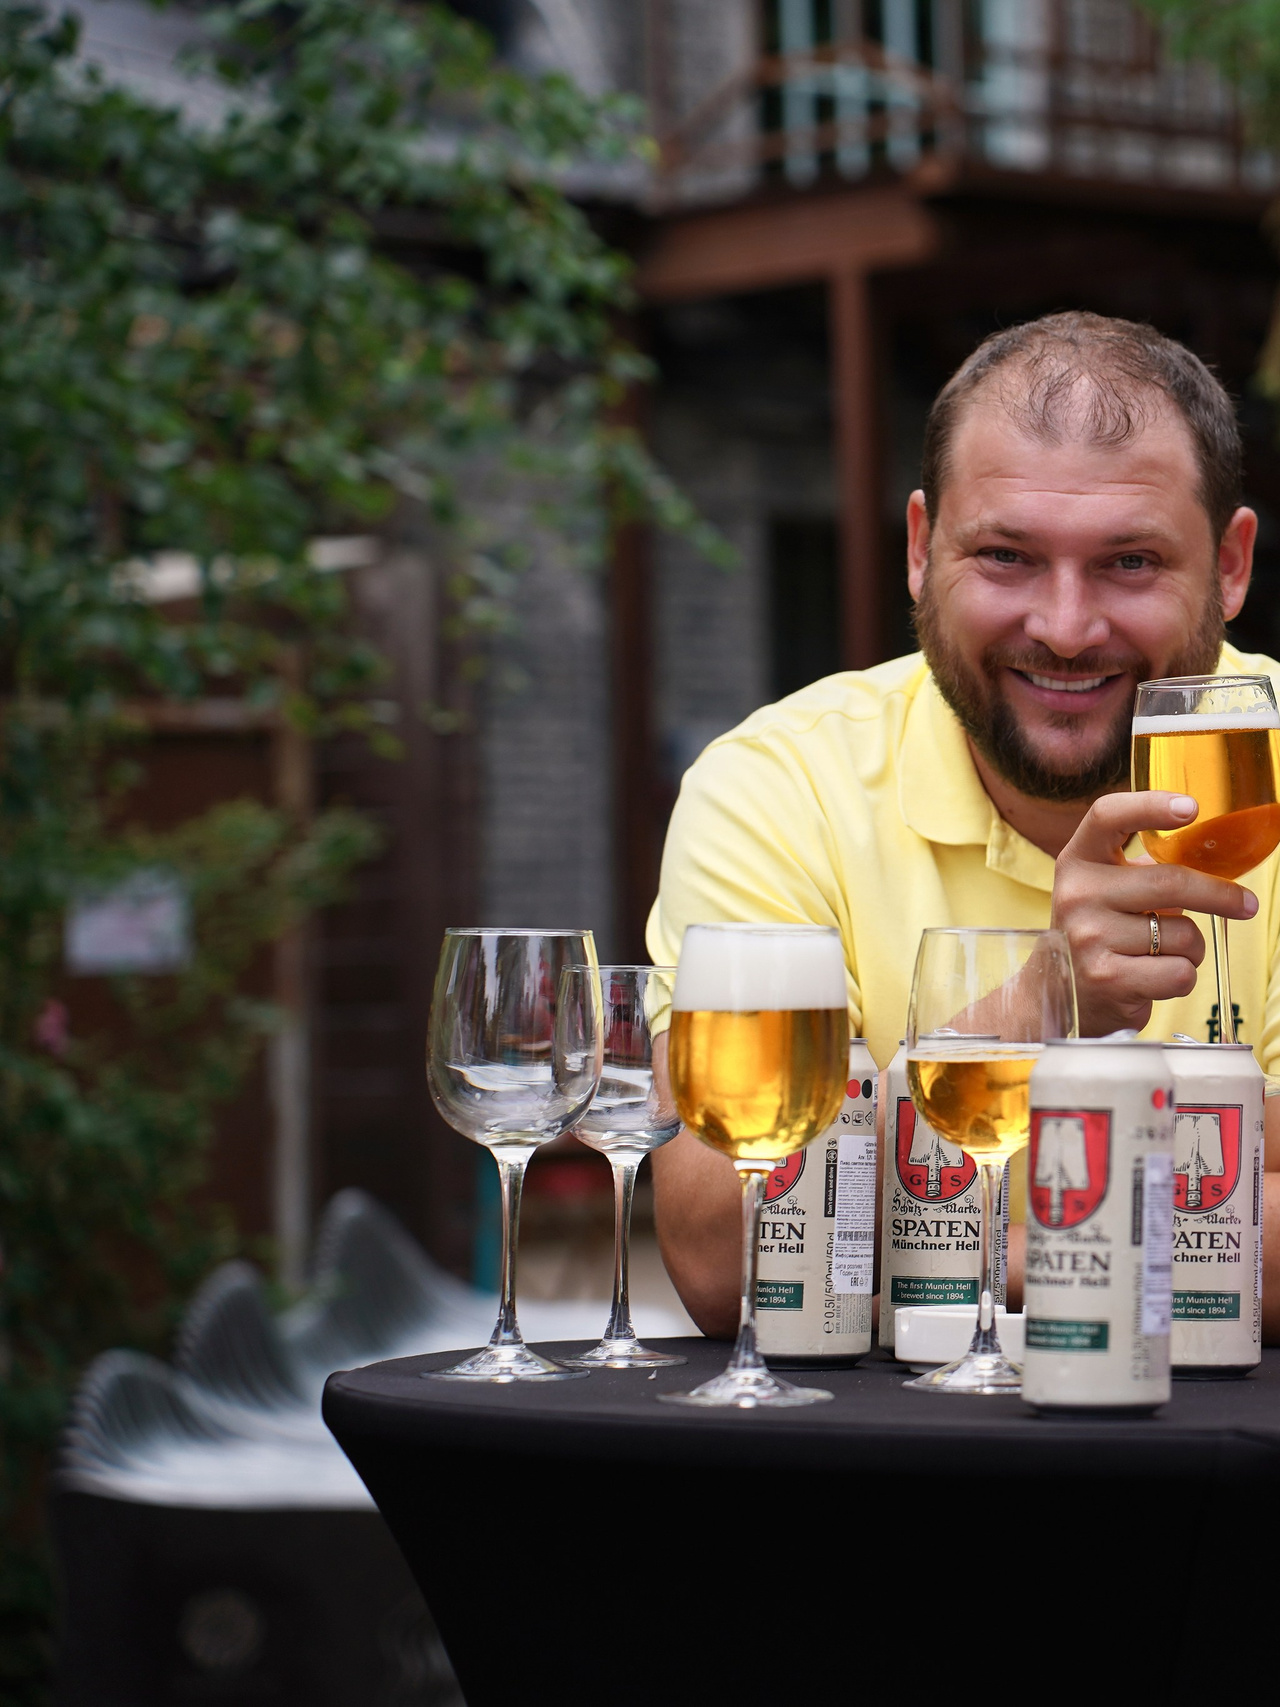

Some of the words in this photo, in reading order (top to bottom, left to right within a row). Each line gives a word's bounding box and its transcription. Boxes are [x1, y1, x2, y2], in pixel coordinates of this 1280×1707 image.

[760, 1221, 807, 1241] TEN
[892, 1218, 982, 1238] SPATEN
[892, 1239, 952, 1250] Münchner
[955, 1240, 980, 1251] Hell
[1172, 1231, 1242, 1249] ATEN
[778, 1243, 805, 1254] Hell
[1172, 1252, 1213, 1262] chner
[1217, 1252, 1241, 1263] Hell
[778, 1286, 795, 1295] Hell
[897, 1281, 908, 1289] The
[909, 1281, 923, 1289] first
[925, 1282, 954, 1290] Munich
[769, 1296, 787, 1305] 1894
[900, 1291, 924, 1299] brewed
[925, 1292, 944, 1300] since
[946, 1292, 964, 1300] 1894
[1186, 1296, 1216, 1304] Munich
[1171, 1306, 1185, 1314] wed
[1186, 1306, 1206, 1314] since
[1208, 1306, 1226, 1314] 1894
